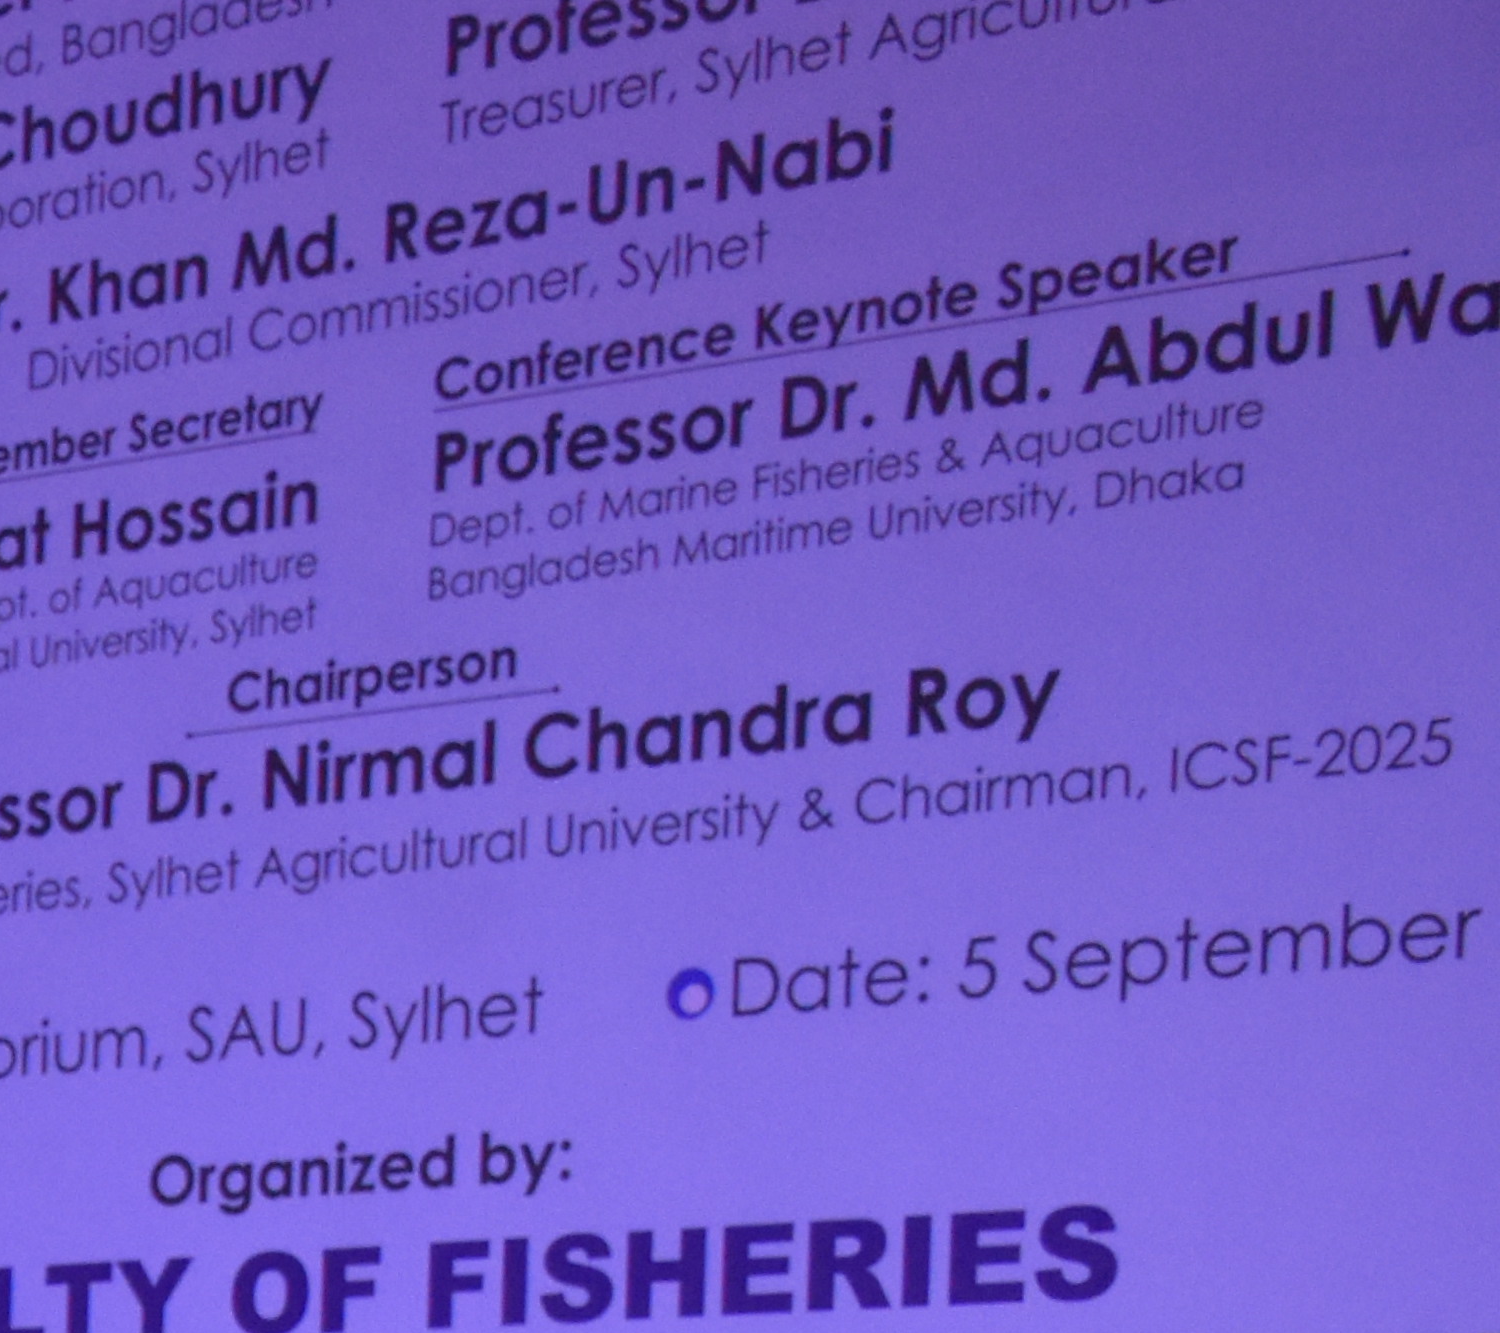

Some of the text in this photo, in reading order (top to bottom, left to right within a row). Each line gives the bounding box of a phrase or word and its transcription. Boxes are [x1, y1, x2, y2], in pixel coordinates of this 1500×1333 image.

[440, 20, 852, 144] Treasurer, Sylhet
[48, 245, 209, 324] Khan
[232, 212, 356, 292] Md.
[384, 107, 896, 263] Reza-Un-Nabi
[192, 127, 330, 200] Sylhet
[26, 219, 770, 393] Divisional Commissioner, Sylhet
[436, 231, 1240, 402] Conference Keynote Speaker
[126, 392, 324, 458] Secretary
[433, 399, 756, 494] Professor
[779, 372, 876, 441] Dr.
[902, 336, 1054, 423] Md.
[1082, 289, 1335, 394] Abdul
[71, 470, 319, 562] Hossain
[426, 455, 1246, 603] Bangladesh Maritime University, Dhaka
[428, 391, 1266, 550] Dept. of Marine Fisheries & Aquaculture
[29, 613, 201, 671] University,
[209, 595, 318, 649] Sylhet
[48, 579, 84, 617] of
[92, 543, 319, 614] Aquaculture
[227, 640, 519, 717] Chairperson
[147, 760, 233, 824] Dr.
[263, 719, 496, 811] Nirmal
[523, 681, 873, 782] Chandra
[906, 663, 1061, 741] Roy
[107, 848, 240, 911] Sylhet
[255, 815, 528, 896] Agricultural
[545, 791, 779, 859] University
[798, 788, 835, 830] &
[854, 757, 1148, 826] Chairman,
[1169, 716, 1454, 793] ICSF-2025
[185, 995, 325, 1065] SAU,
[348, 974, 544, 1060] Sylhet
[729, 901, 1481, 1018] Date: 5 September
[150, 1130, 573, 1216] Organized by:
[426, 1205, 1120, 1329] FISHERIES
